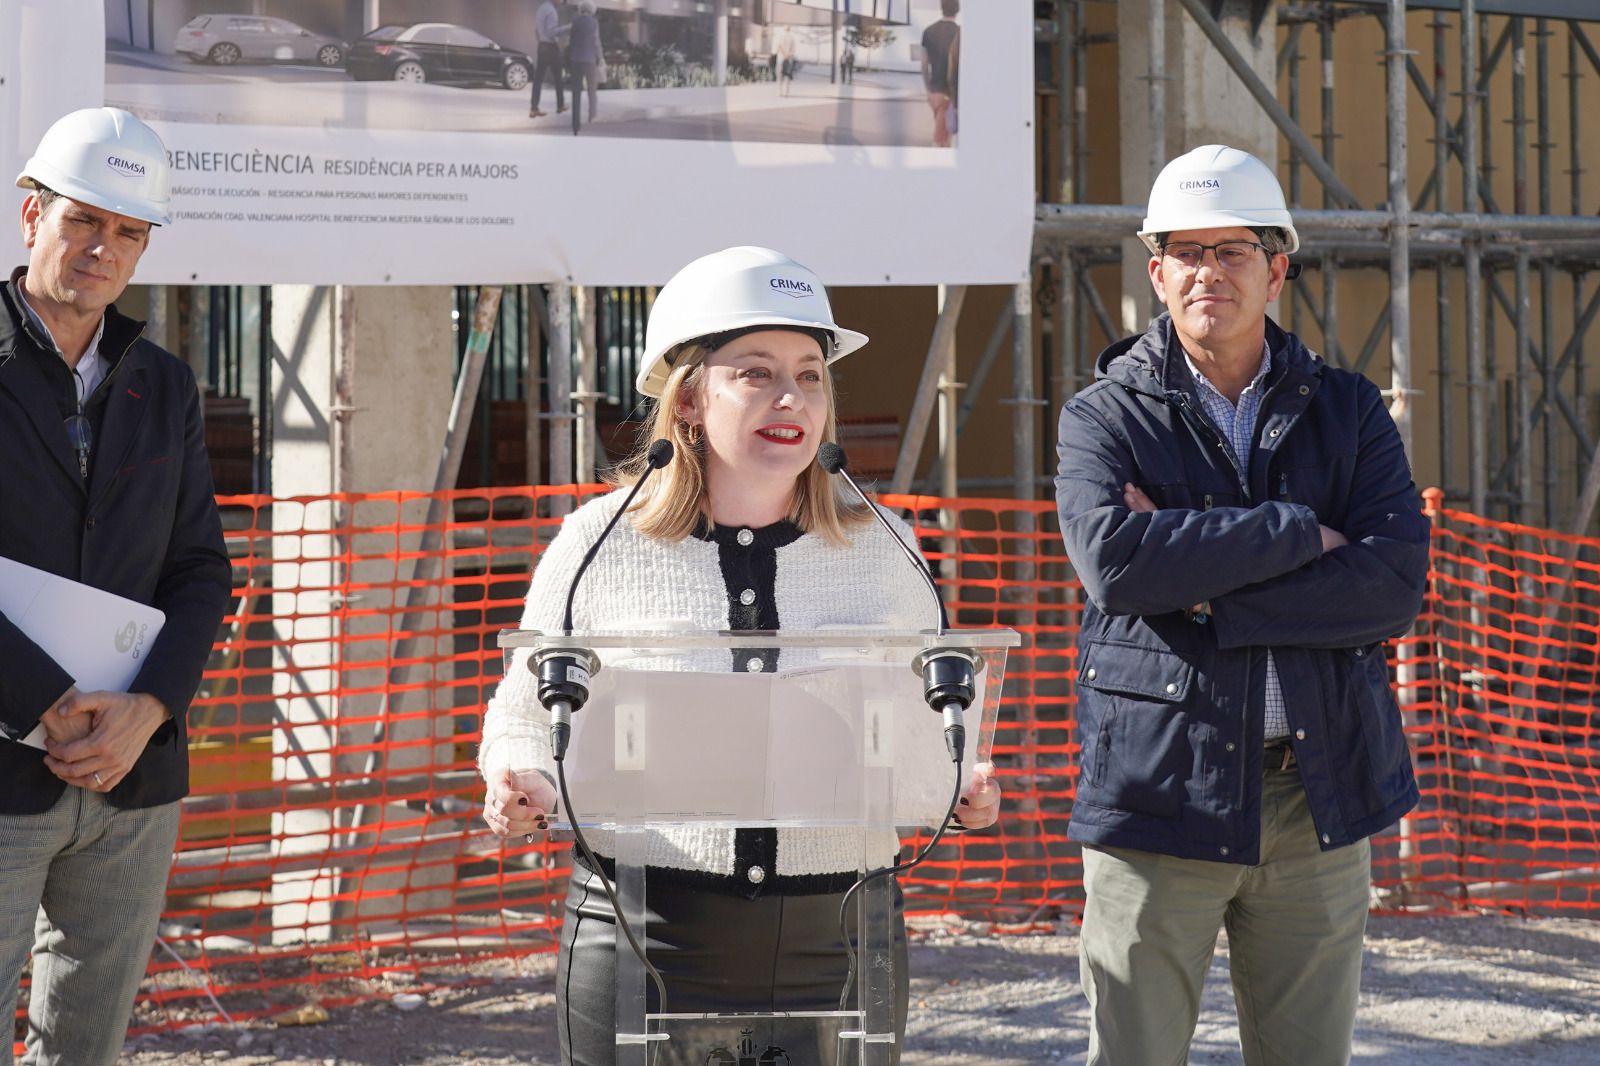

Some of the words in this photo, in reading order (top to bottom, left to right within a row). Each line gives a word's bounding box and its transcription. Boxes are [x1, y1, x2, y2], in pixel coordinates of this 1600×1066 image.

[107, 156, 145, 175] CRIMSA
[324, 157, 413, 177] RESIDÈNCIA
[416, 162, 445, 178] PER
[448, 163, 458, 177] A
[461, 164, 519, 179] MAJORS
[1179, 179, 1220, 190] CRIMSA
[268, 190, 313, 198] RESIDENCIA
[315, 191, 334, 199] PARA
[336, 191, 376, 200] PERSONAS
[378, 192, 411, 201] MAYORES
[176, 210, 222, 220] FUNDACIÓN
[247, 213, 294, 222] VALENCIANA
[295, 213, 331, 223] HOSPITAL
[389, 215, 422, 224] NUESTRA
[455, 216, 464, 225] DE
[466, 216, 480, 226] LOS
[482, 216, 515, 226] DOLORES
[770, 278, 814, 295] CRIMSA
